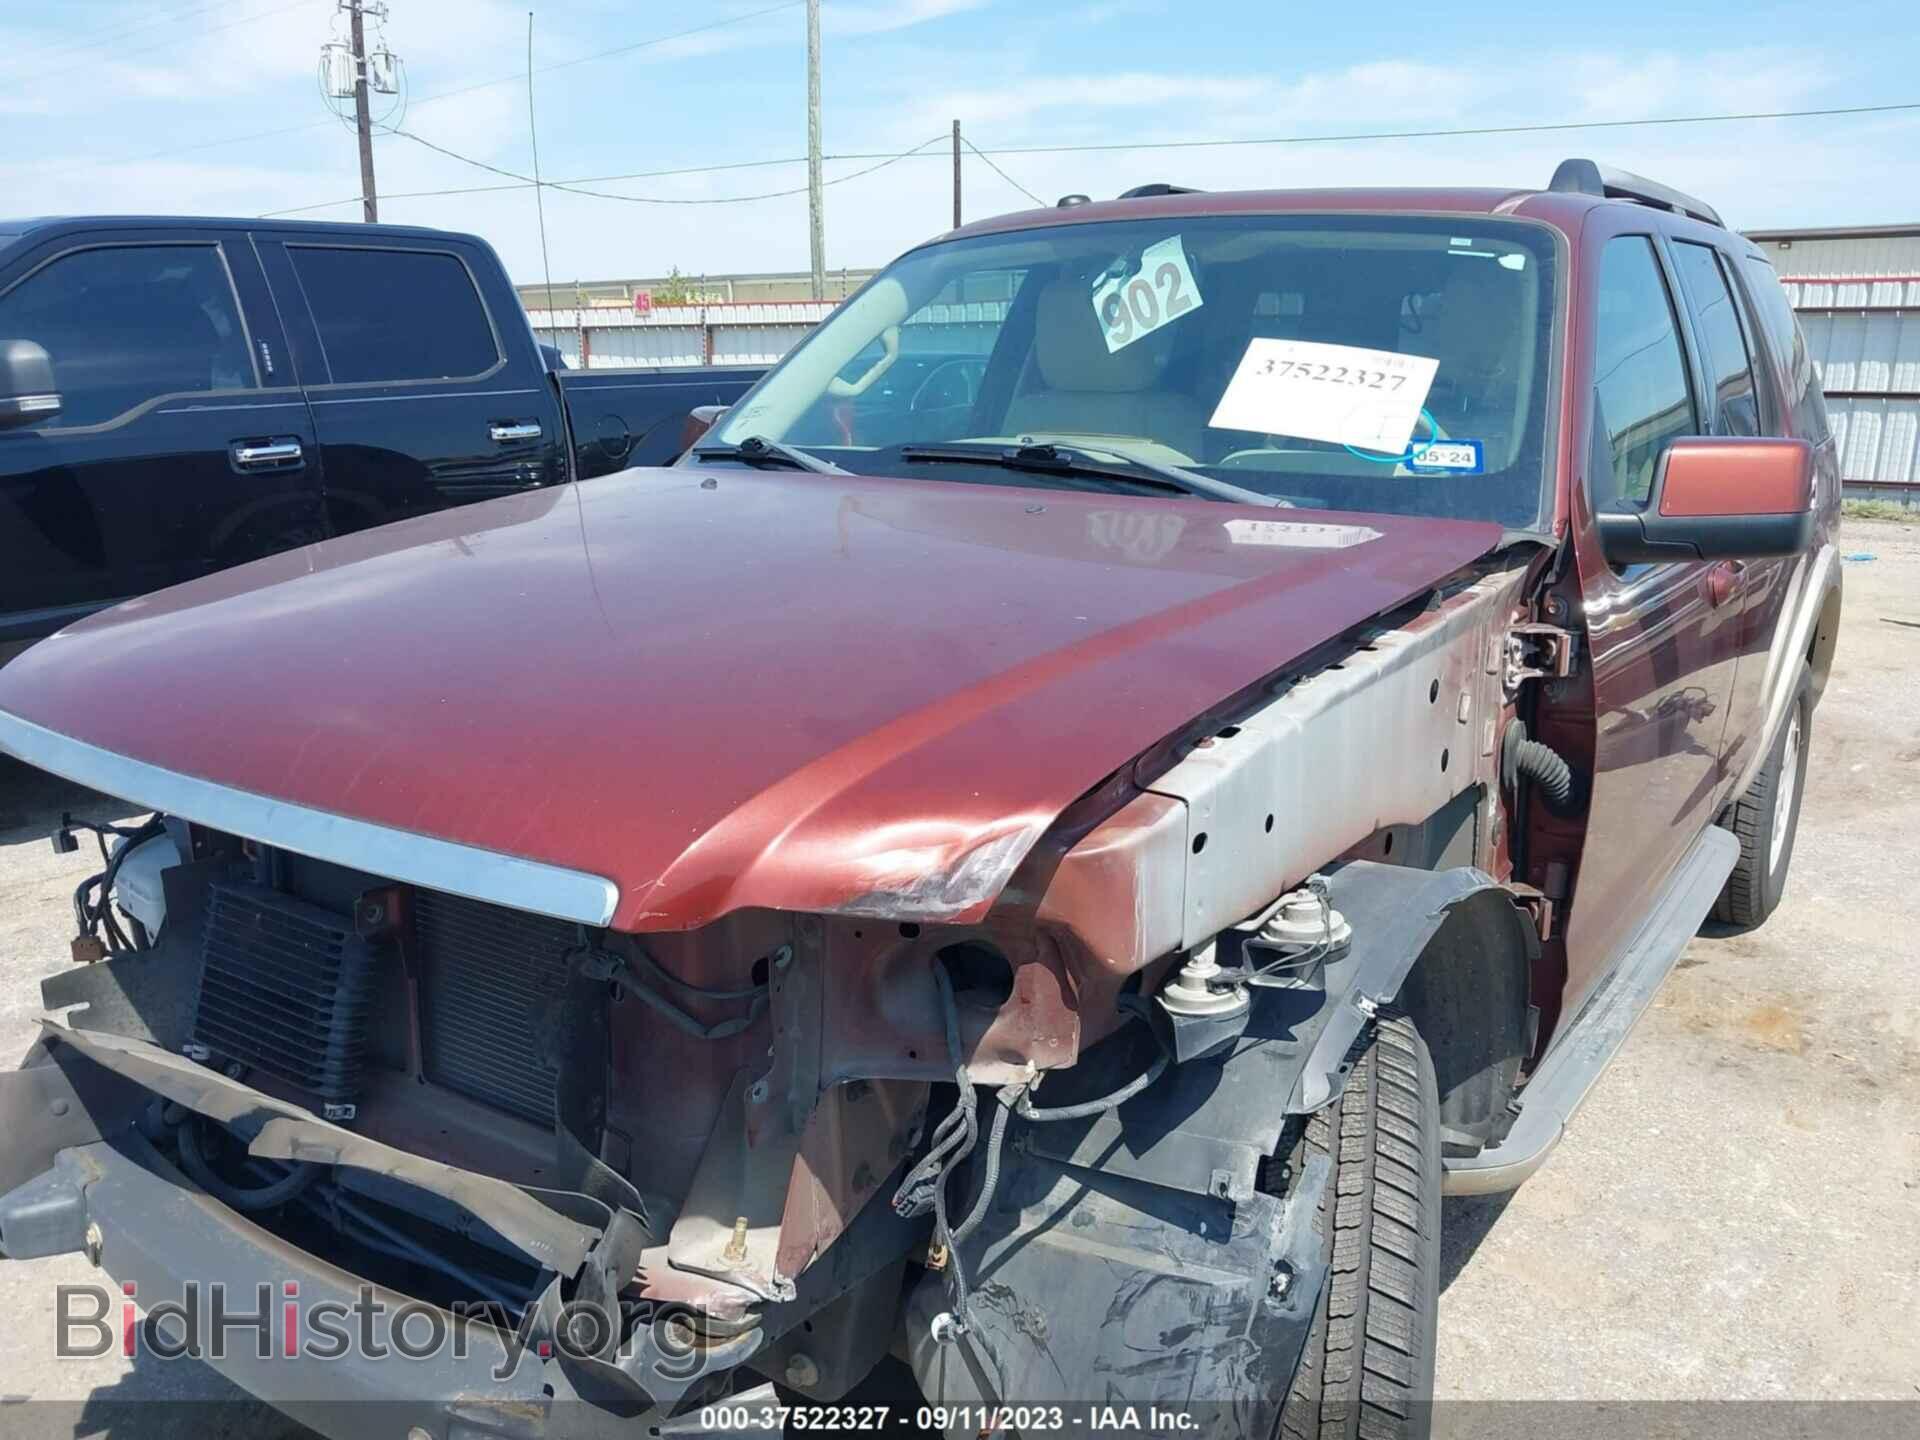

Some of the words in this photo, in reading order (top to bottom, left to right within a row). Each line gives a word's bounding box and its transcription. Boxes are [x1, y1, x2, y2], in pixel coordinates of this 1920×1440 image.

[636, 293, 649, 311] 45
[1101, 262, 1193, 344] 902
[1256, 359, 1407, 391] 37522327
[1448, 451, 1472, 464] 24
